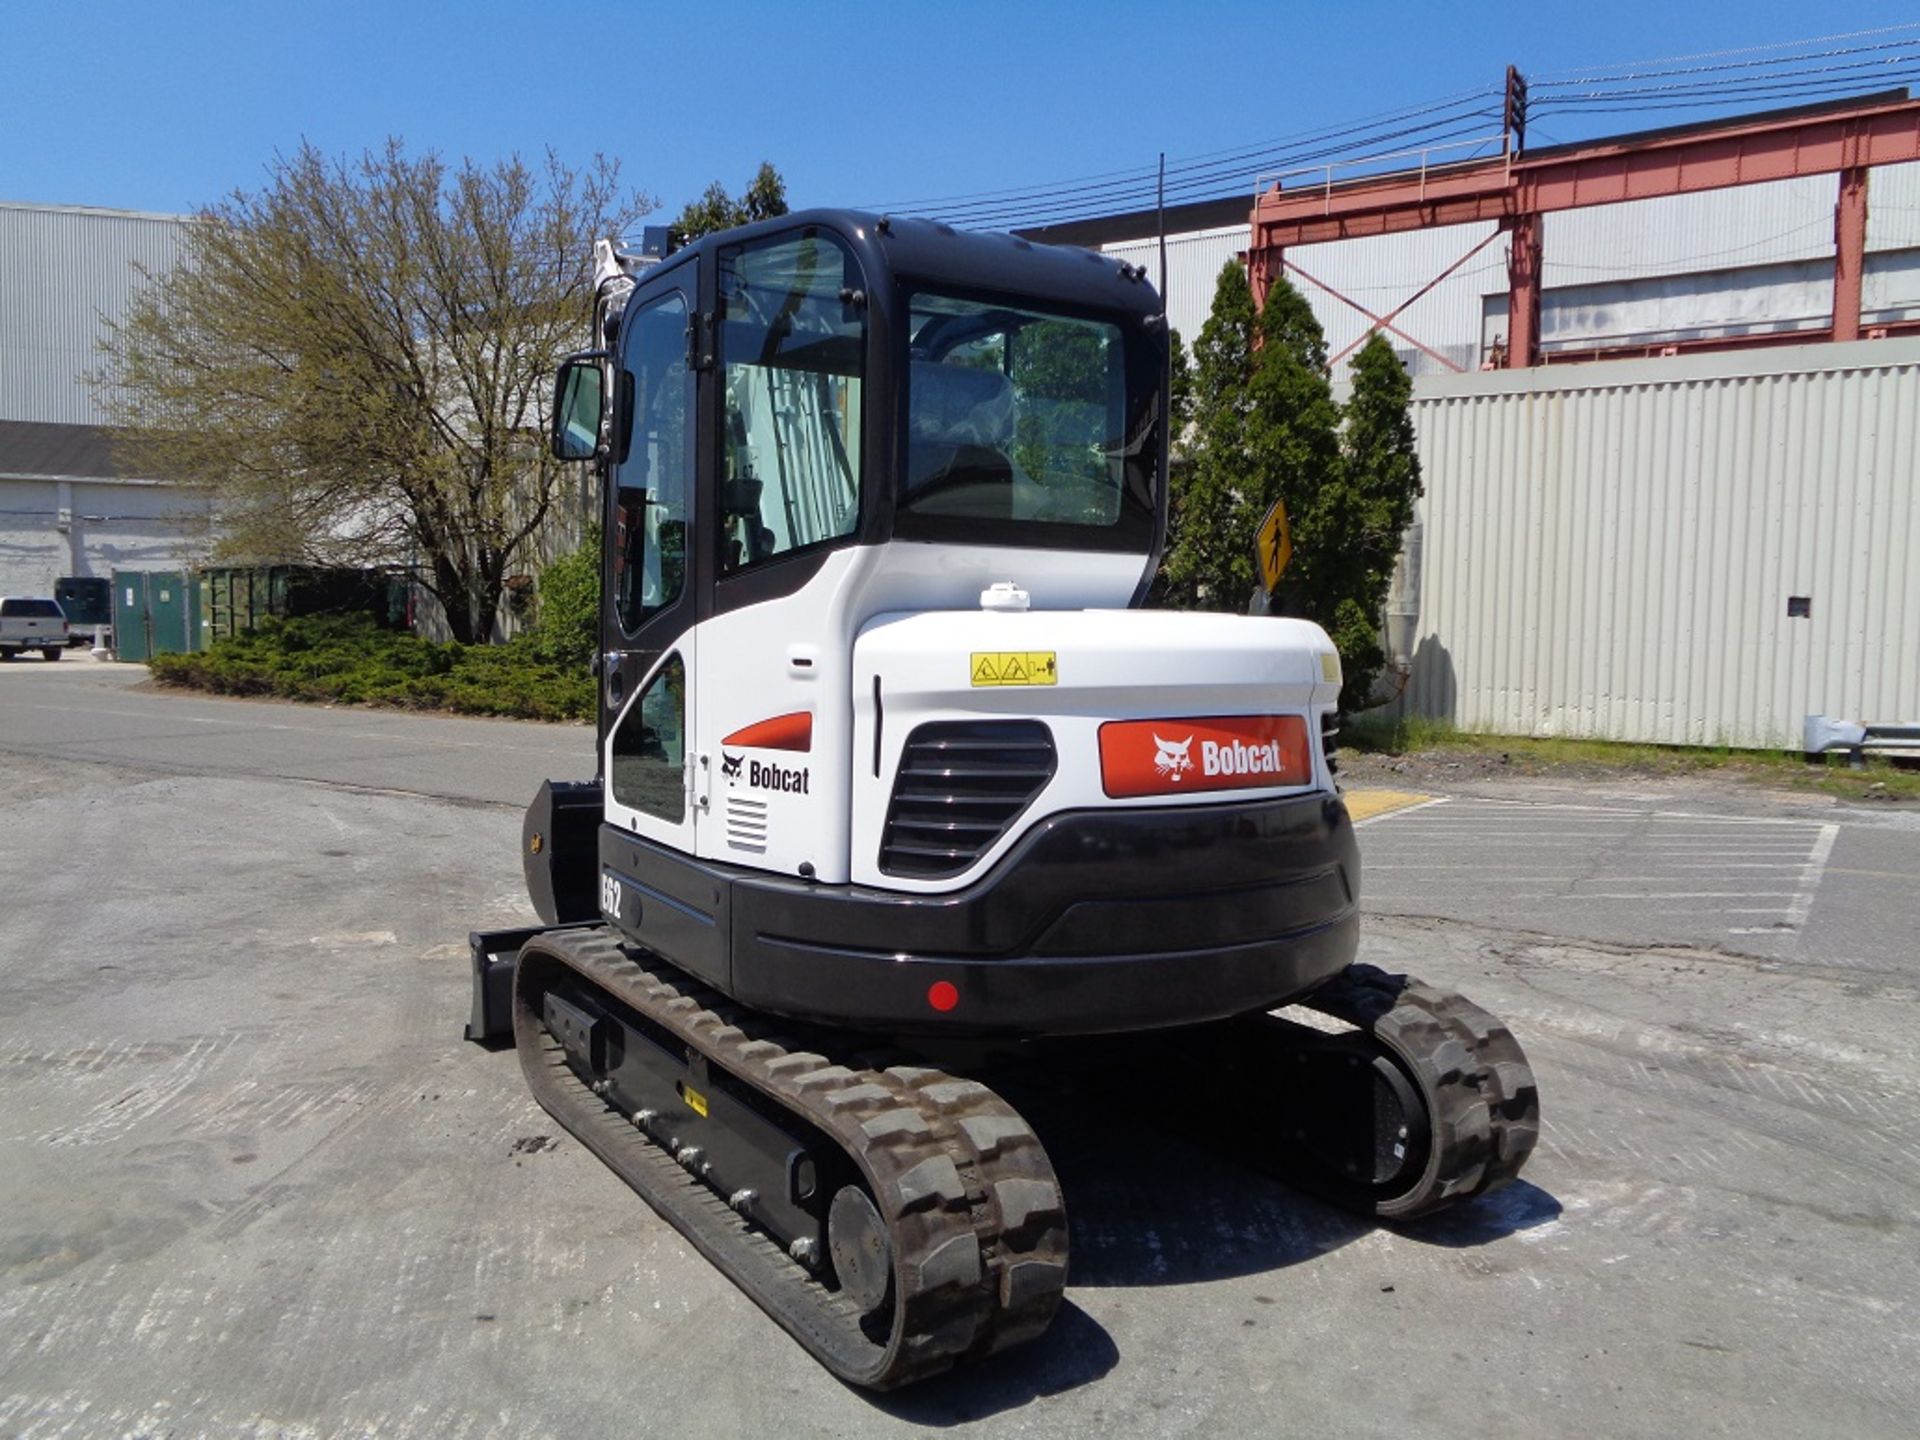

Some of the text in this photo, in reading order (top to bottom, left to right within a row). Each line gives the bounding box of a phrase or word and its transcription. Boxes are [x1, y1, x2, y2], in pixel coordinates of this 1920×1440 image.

[1202, 739, 1282, 776] Bobcat
[750, 760, 809, 795] Bobcat
[602, 873, 621, 919] E62
